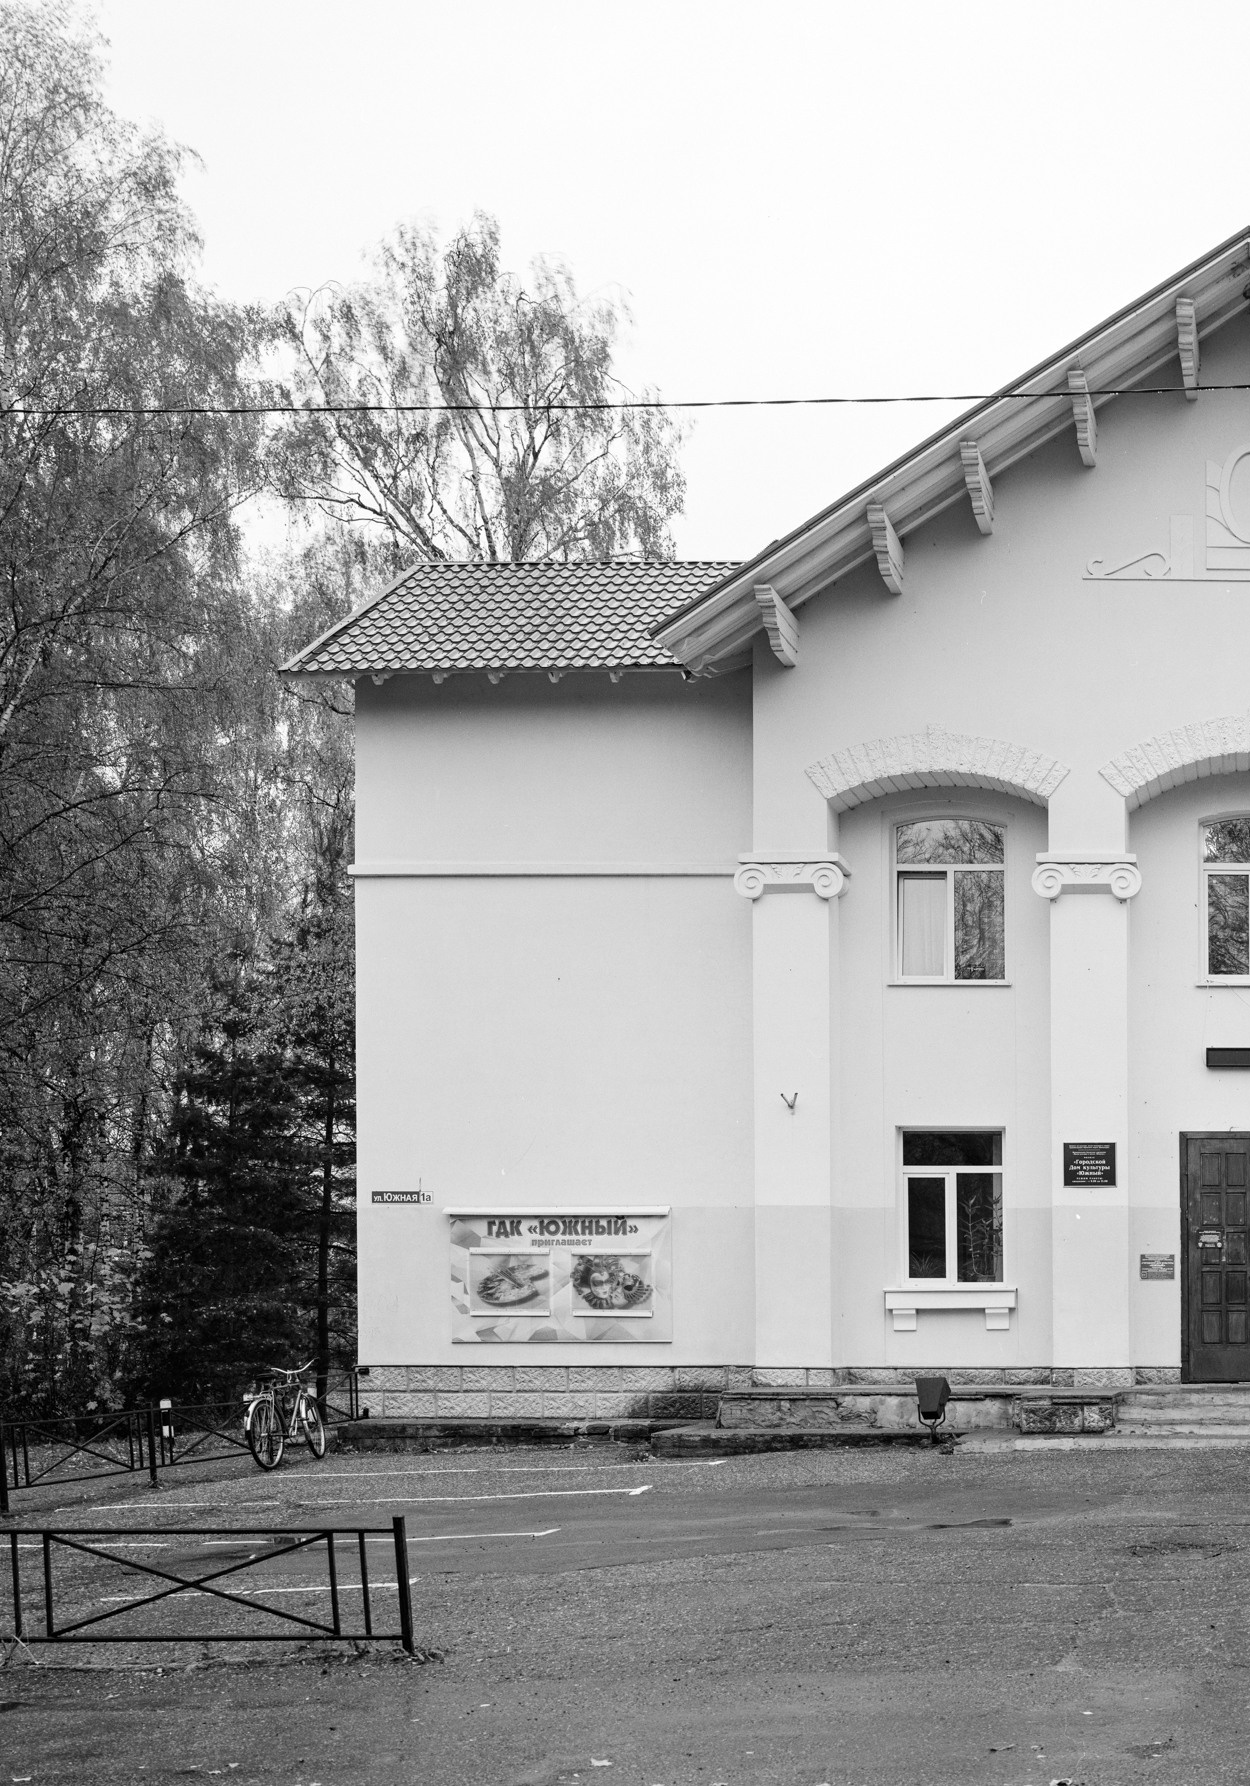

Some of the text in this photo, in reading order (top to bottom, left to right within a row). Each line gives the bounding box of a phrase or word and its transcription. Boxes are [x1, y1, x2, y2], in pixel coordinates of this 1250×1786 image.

[383, 1192, 418, 1202] ЮЖНАЯ
[420, 1192, 432, 1202] 1а
[487, 1215, 639, 1239] ГДК «ЮЖНЫЙ»
[531, 1238, 593, 1248] приглашает
